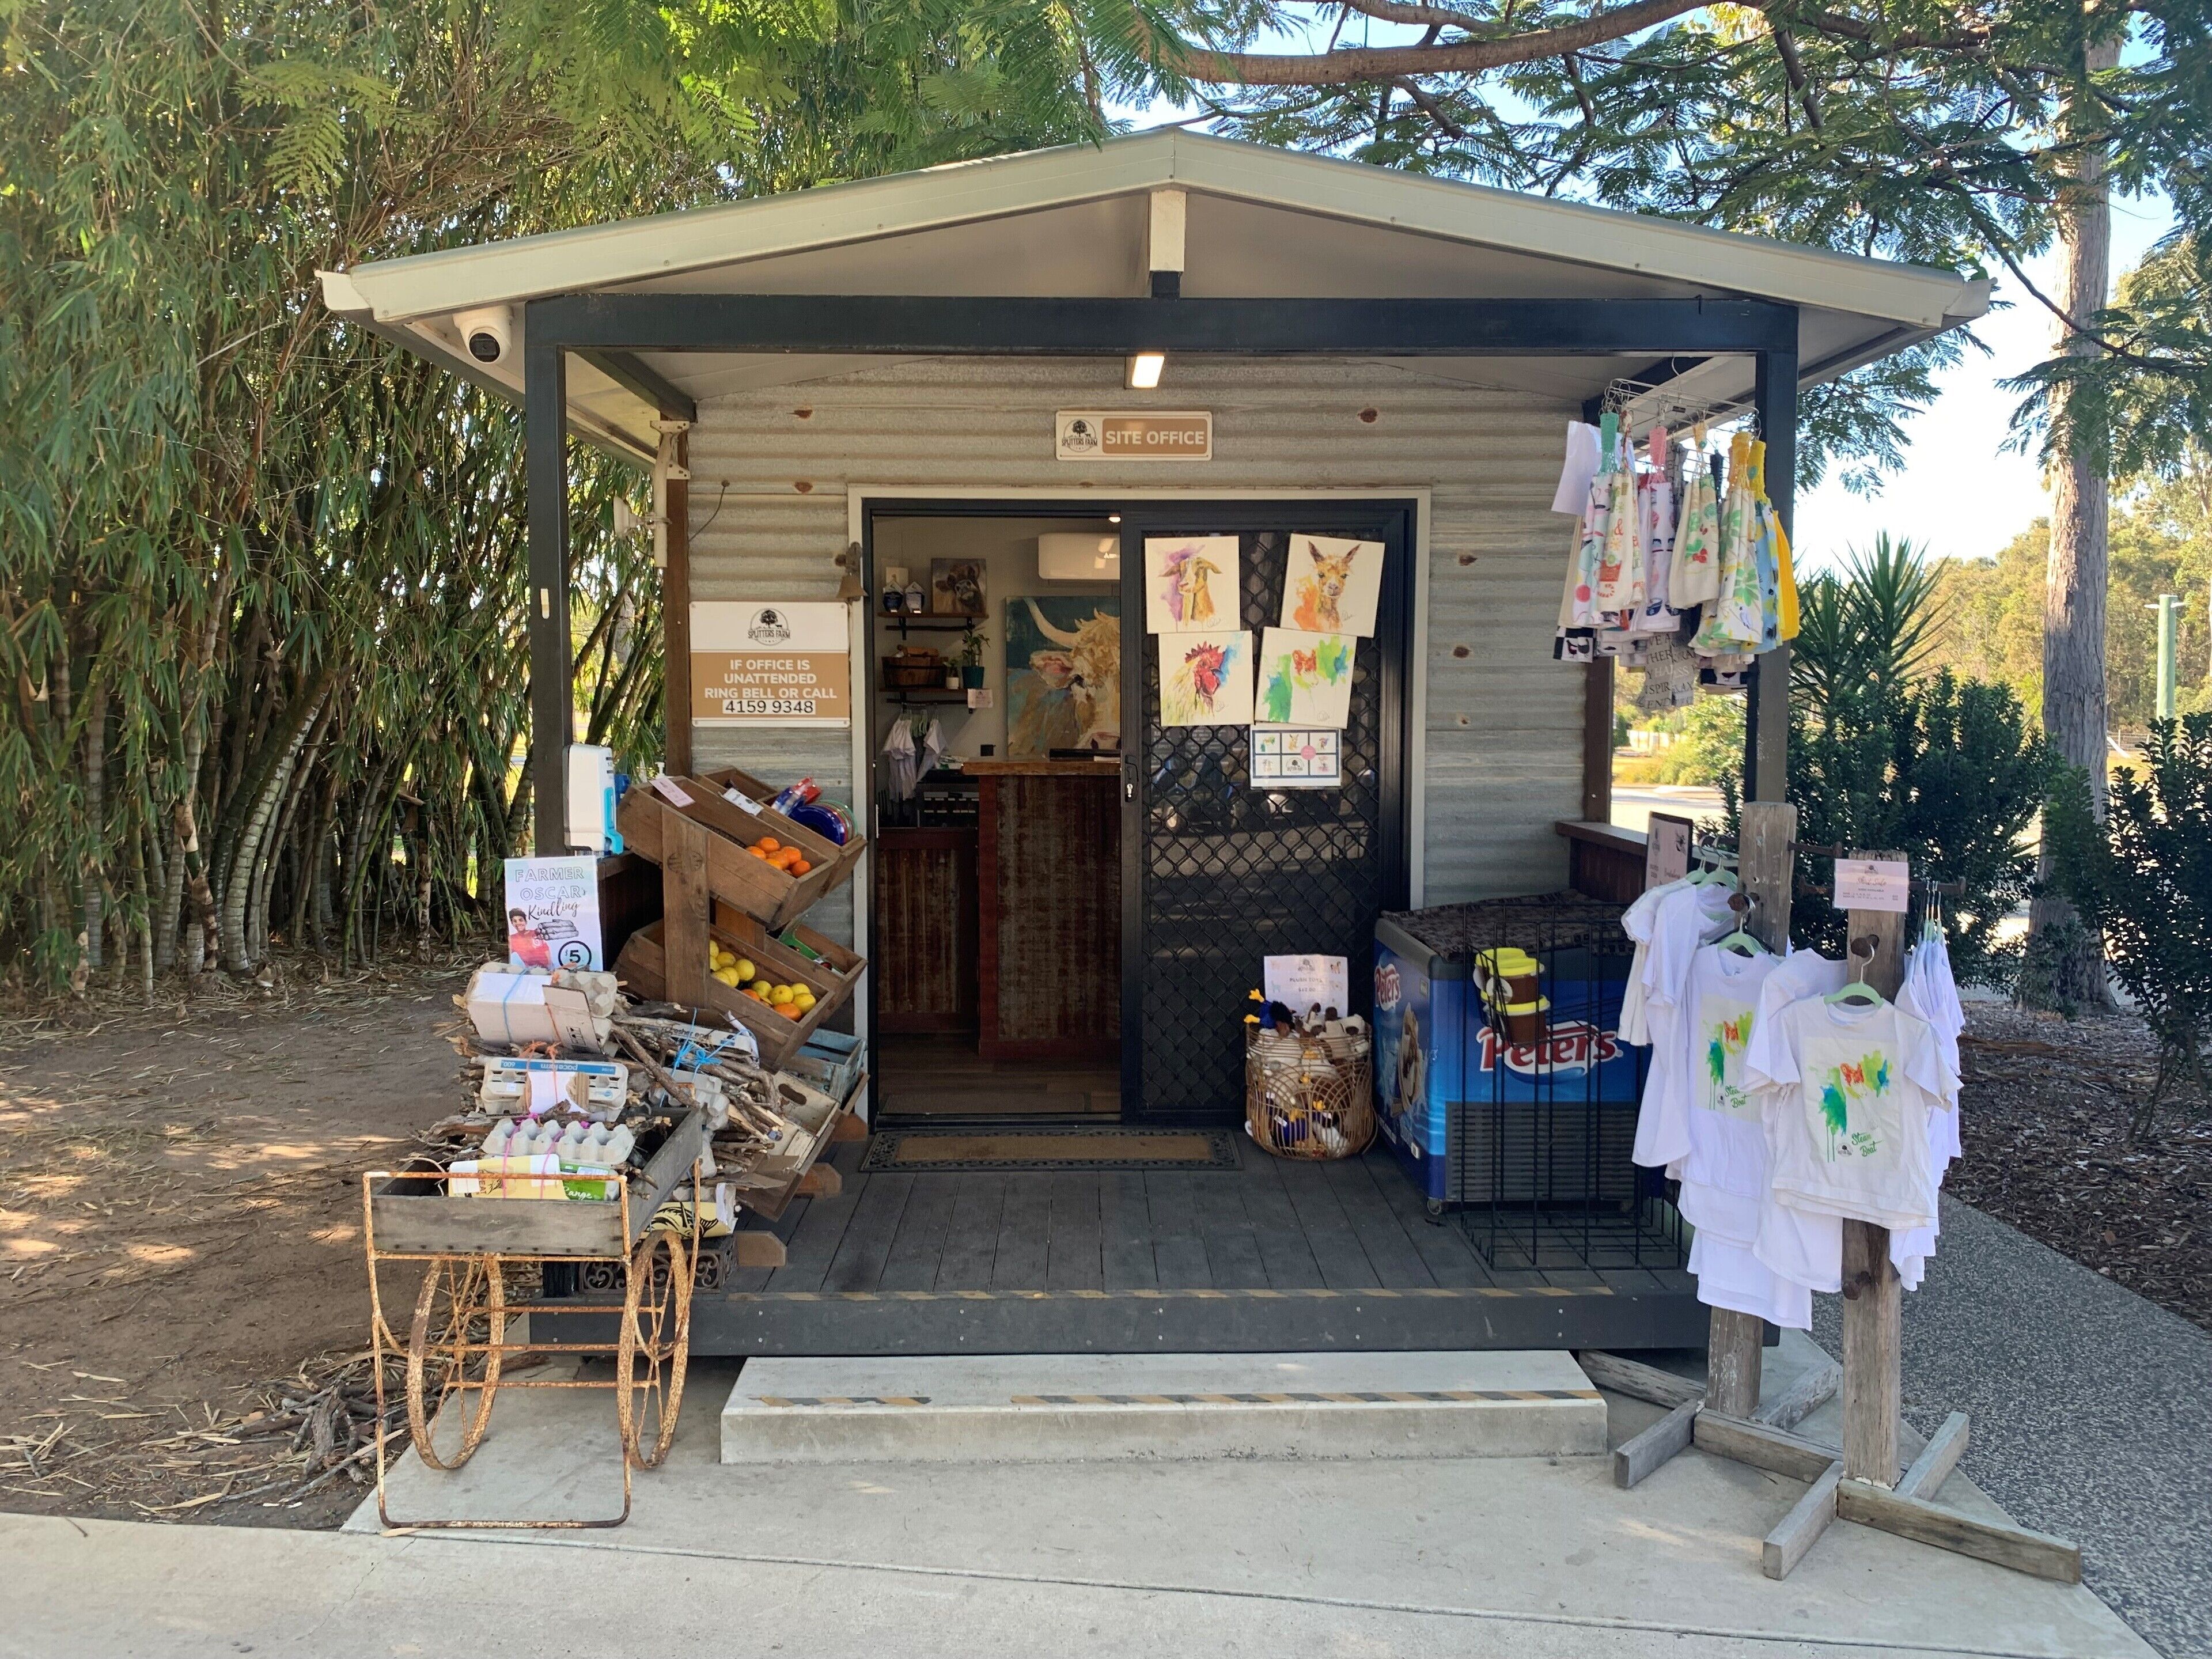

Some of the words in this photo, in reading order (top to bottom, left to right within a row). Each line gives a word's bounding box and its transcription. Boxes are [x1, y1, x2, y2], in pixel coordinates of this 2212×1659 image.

[1105, 430, 1142, 445] SITE
[1146, 430, 1205, 445] OFFICE
[775, 629, 790, 639] FARM
[730, 660, 742, 671] IF
[746, 660, 793, 671] OFFICE
[797, 660, 810, 671] IS
[724, 673, 817, 684] UNATTENDED
[704, 688, 738, 699] RING
[743, 688, 775, 699] BELL
[779, 688, 800, 699] OR
[802, 688, 838, 699] CALL
[725, 700, 767, 713] 4159
[772, 700, 814, 713] 9348
[515, 866, 584, 882] FARMER
[528, 897, 578, 920] Kindling
[1478, 1024, 1617, 1070] Peters
[1725, 1085, 1740, 1097] Stea
[1851, 1132, 1872, 1145] Steam
[1860, 1141, 1884, 1157] Boat
